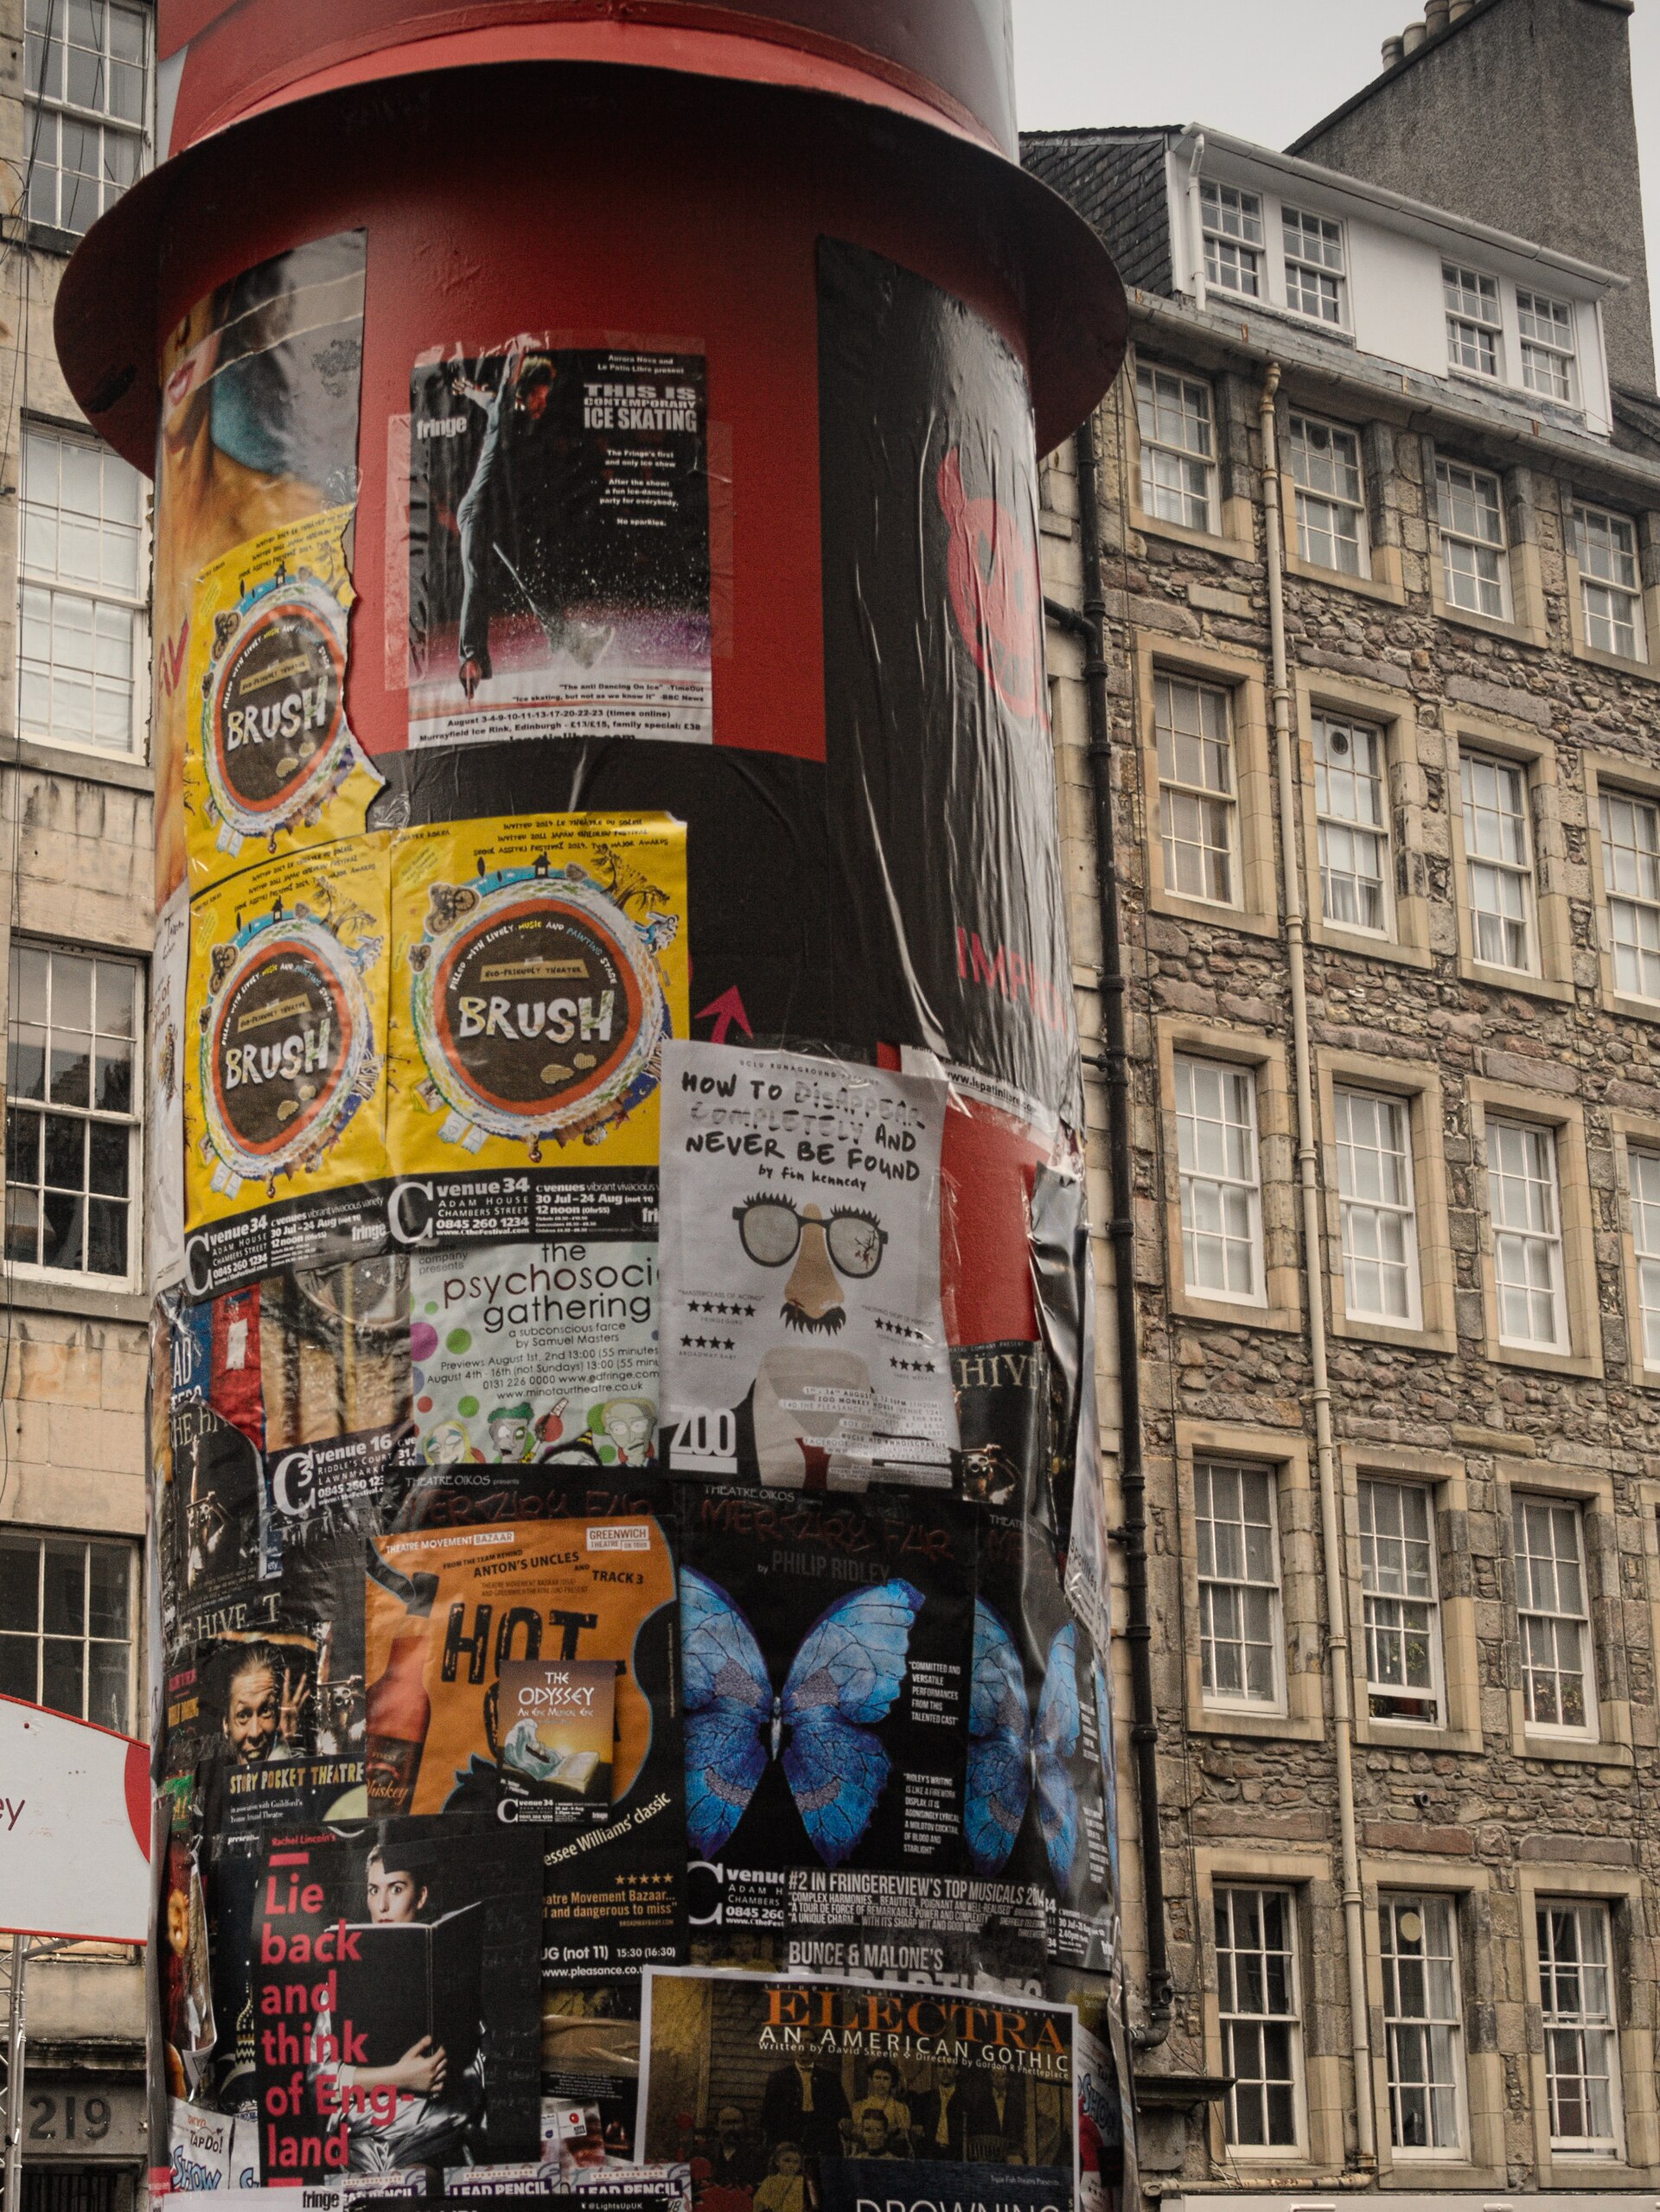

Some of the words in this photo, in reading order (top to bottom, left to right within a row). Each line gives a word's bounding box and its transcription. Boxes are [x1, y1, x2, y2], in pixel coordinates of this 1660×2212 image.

[584, 383, 656, 398] THIS
[664, 386, 696, 400] IS
[584, 398, 696, 409] CONTEMPORARY
[417, 417, 468, 440] fringe
[584, 407, 615, 430] ICE
[617, 408, 697, 432] SKATING
[622, 459, 638, 468] only
[624, 449, 655, 458] Fringe's
[635, 498, 679, 507] everybody.
[227, 675, 329, 751] BRUSH
[447, 716, 479, 728] August
[606, 710, 636, 718] (times
[638, 710, 671, 719] online)
[458, 990, 616, 1044] BRUSH
[226, 1018, 331, 1090] BRUSH
[682, 1071, 737, 1099] HOW
[750, 1080, 783, 1101] TO
[686, 1131, 786, 1159] NEVER
[797, 1140, 836, 1165] BE
[847, 1148, 921, 1182] FOUND
[436, 1179, 501, 1198] venue
[502, 1176, 531, 1193] 34
[758, 1163, 774, 1180] by
[812, 1170, 867, 1192] kennedy
[437, 1208, 491, 1218] CHAMBERS
[494, 1206, 529, 1215] STREET
[438, 1199, 477, 1208] ADAM
[486, 1196, 529, 1206] HOUSE
[210, 1222, 249, 1246] venue
[250, 1214, 268, 1233] 34
[351, 1222, 387, 1242] fringe
[436, 1218, 469, 1229] 0845
[472, 1218, 498, 1229] 260
[500, 1217, 530, 1227] 1234
[213, 1243, 235, 1256] ADAM
[239, 1234, 268, 1247] HOUSE
[541, 1242, 587, 1263] the
[444, 1258, 659, 1310] psychosoci
[482, 1292, 650, 1334] gathering
[508, 1329, 516, 1338] a
[519, 1323, 594, 1337] subconscious
[596, 1321, 627, 1332] farce
[515, 1338, 530, 1349] by
[532, 1335, 574, 1348] Samuel
[578, 1333, 620, 1345] Masters
[440, 1357, 485, 1371] Previews
[488, 1355, 524, 1367] August
[545, 1350, 566, 1361] 2nd
[569, 1348, 597, 1360] 13:00
[598, 1348, 615, 1360] (55
[617, 1346, 659, 1357] minutes
[426, 1372, 463, 1385] August
[465, 1370, 482, 1380] 4th
[490, 1367, 512, 1378] 16th
[514, 1365, 534, 1377] (not
[536, 1361, 584, 1375] Sundays)
[586, 1359, 614, 1370] 13:00
[616, 1357, 634, 1370] (55
[483, 1378, 507, 1390] 0131
[508, 1377, 527, 1388] 226
[529, 1374, 556, 1386] 0000
[558, 1369, 661, 1385] www.edfringe.com
[496, 1381, 644, 1400] www.minotaurtheatre.co.uk
[669, 1405, 737, 1457] ZOO
[315, 1442, 367, 1465] venue
[370, 1433, 393, 1452] 16
[318, 1459, 359, 1476] RIDDLE'S
[361, 1453, 393, 1466] COURT
[386, 1540, 419, 1554] THEATRE
[420, 1535, 473, 1549] MOVEMENT
[475, 1533, 514, 1545] BAZAAR
[589, 1528, 648, 1541] GREENWICH
[473, 1559, 528, 1578] ANTON'S
[530, 1552, 580, 1569] UNCLES
[592, 1570, 635, 1584] TRACK
[635, 1574, 645, 1584] 3
[441, 1603, 599, 1686] HOT
[545, 1671, 569, 1685] THE
[912, 1673, 944, 1686] VERSATILE
[518, 1686, 596, 1705] ODYSSEY
[912, 1686, 959, 1700] PERFORMANCES
[229, 1772, 259, 1794] STORY
[261, 1767, 306, 1790] POCKET
[311, 1762, 365, 1786] THEATRE
[576, 1814, 632, 1852] Williams'
[634, 1792, 672, 1824] classic
[271, 1834, 300, 1847] Rachel
[300, 1833, 336, 1844] Lincoln's
[265, 1873, 325, 1916] Lie
[729, 1884, 767, 1895] ADAM
[788, 1871, 808, 1891] #2
[812, 1872, 826, 1891] IN
[830, 1873, 942, 1896] FRINGEREVIEW'S
[944, 1878, 967, 1900] TOP
[968, 1881, 1025, 1903] MUSICALS
[551, 1906, 571, 1918] and
[573, 1904, 630, 1919] dangerous
[632, 1903, 644, 1916] to
[647, 1902, 678, 1915] miss"
[728, 1894, 780, 1907] CHAMBERS
[725, 1906, 759, 1919] 0845
[761, 1908, 784, 1920] 260
[261, 1918, 362, 1965] back
[563, 1946, 591, 1961] (not
[594, 1946, 610, 1960] 11)
[616, 1947, 643, 1958] 15:30
[644, 1947, 676, 1959] (16:30)
[788, 1941, 844, 1966] BUNCE
[848, 1944, 859, 1967] &
[864, 1945, 944, 1971] MALONE'S
[261, 1969, 337, 2015] and
[762, 1989, 1066, 2056] ELECTRA
[261, 2019, 368, 2066] think
[759, 2026, 801, 2044] AN
[820, 2028, 968, 2060] AMERICAN
[981, 2044, 1069, 2073] GOTHIC
[758, 2040, 806, 2054] Written
[809, 2043, 824, 2055] by
[827, 2044, 860, 2056] David
[864, 2047, 899, 2059] Skeele
[916, 2053, 960, 2066] Directed
[962, 2057, 974, 2069] by
[975, 2059, 1008, 2073] Gordon
[1018, 2065, 1069, 2081] Phetteplace
[265, 2072, 305, 2117] of
[316, 2075, 415, 2126] Eng-
[28, 2094, 112, 2141] 219
[267, 2122, 349, 2169] land
[172, 2145, 222, 2190] SHOW
[303, 2190, 340, 2211] fringe
[588, 2201, 643, 2212] @LightsUpUK
